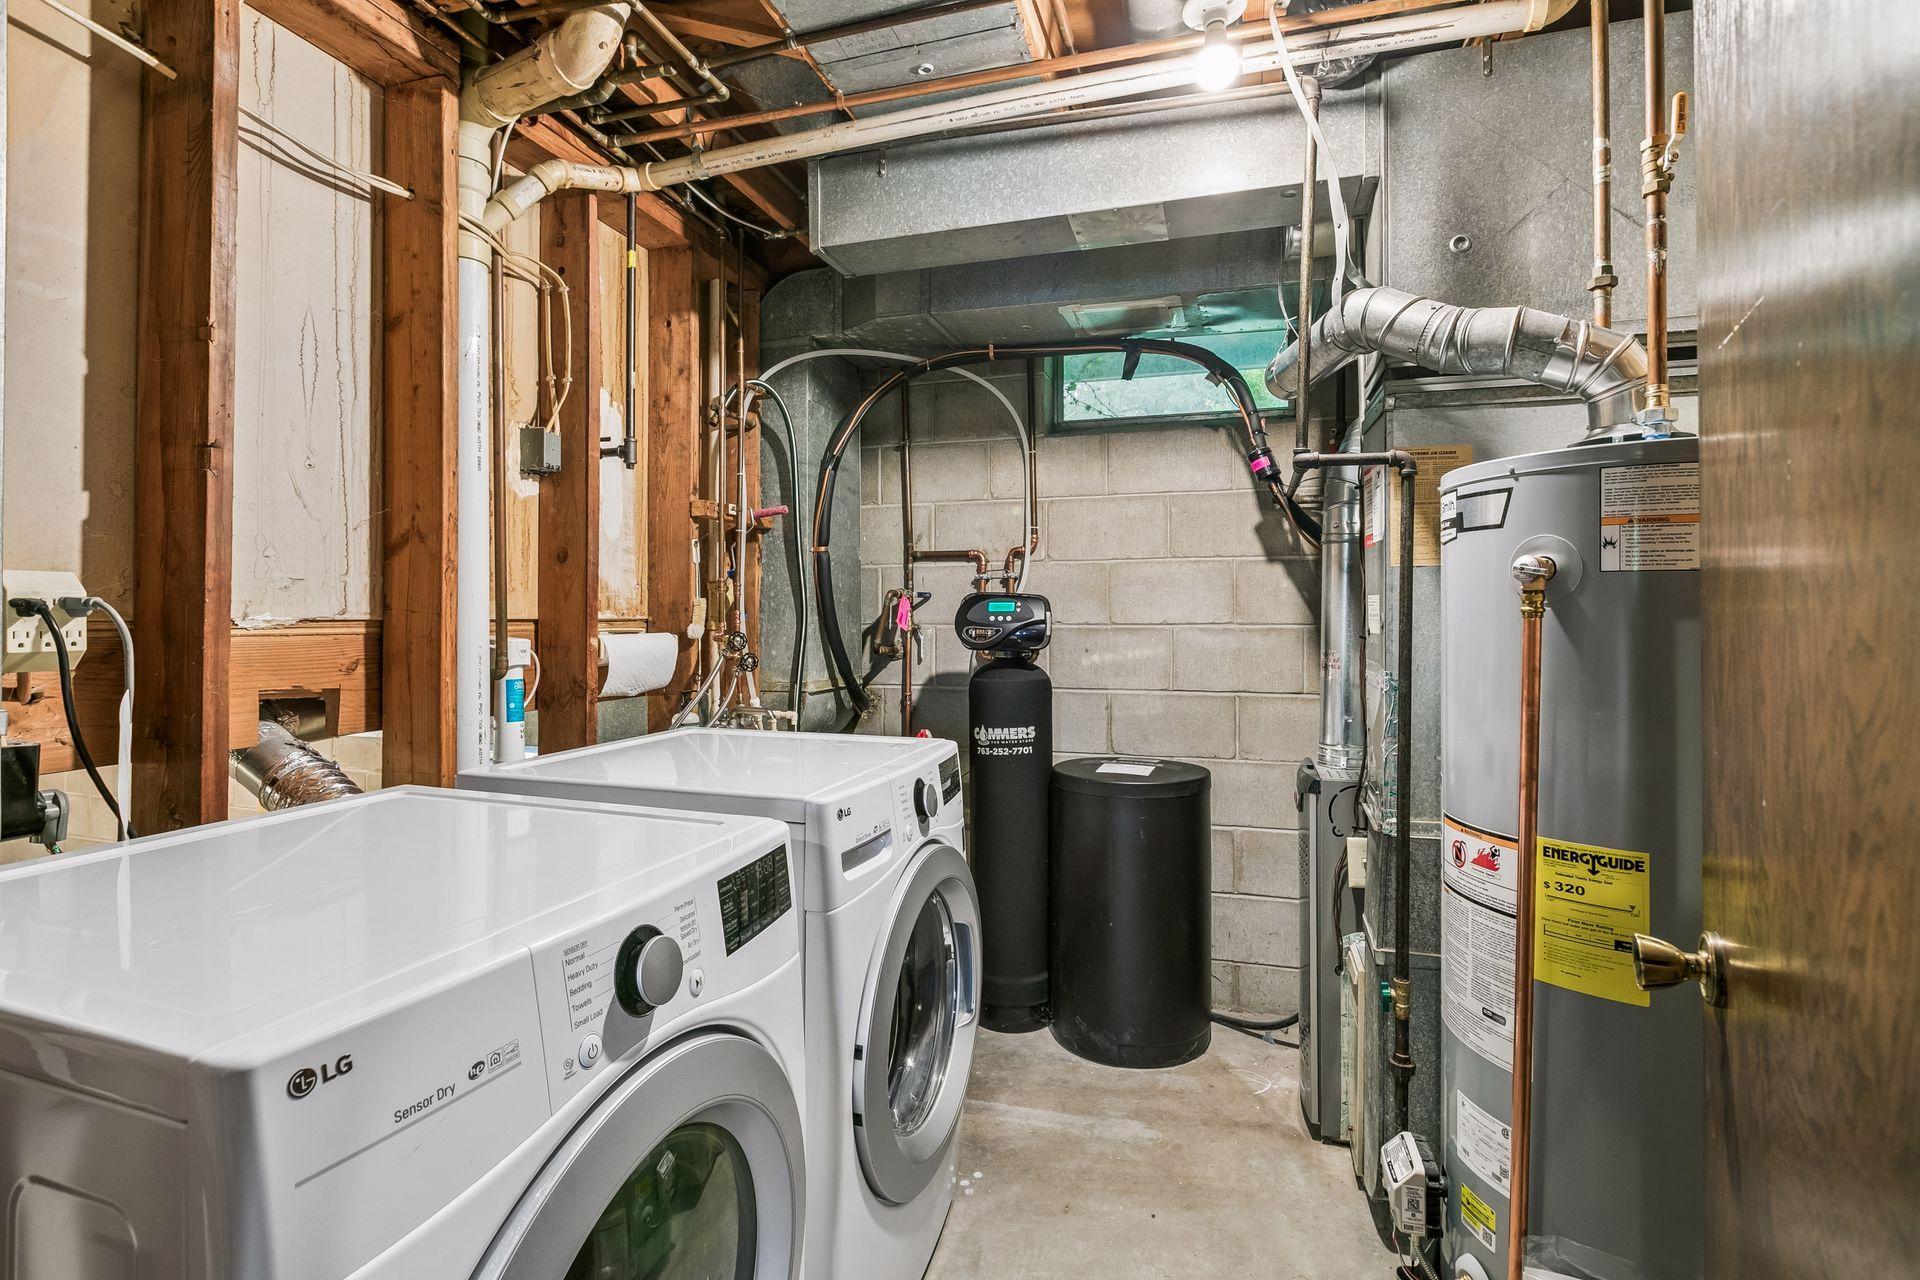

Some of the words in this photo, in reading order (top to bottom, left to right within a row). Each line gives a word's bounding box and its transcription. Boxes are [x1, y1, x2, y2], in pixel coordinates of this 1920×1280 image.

[976, 746, 1033, 756] 763-252-7701
[844, 807, 852, 817] LG
[1554, 881, 1586, 896] 320
[565, 952, 586, 967] Normal
[567, 968, 585, 982] Heavy
[585, 961, 599, 973] Duty
[569, 981, 593, 997] Bedding
[572, 998, 592, 1013] Towels
[574, 1015, 590, 1030] Small
[590, 1007, 603, 1021] Load
[321, 1054, 353, 1084] LG
[393, 1095, 435, 1124] Sensor
[436, 1083, 456, 1102] Dry
